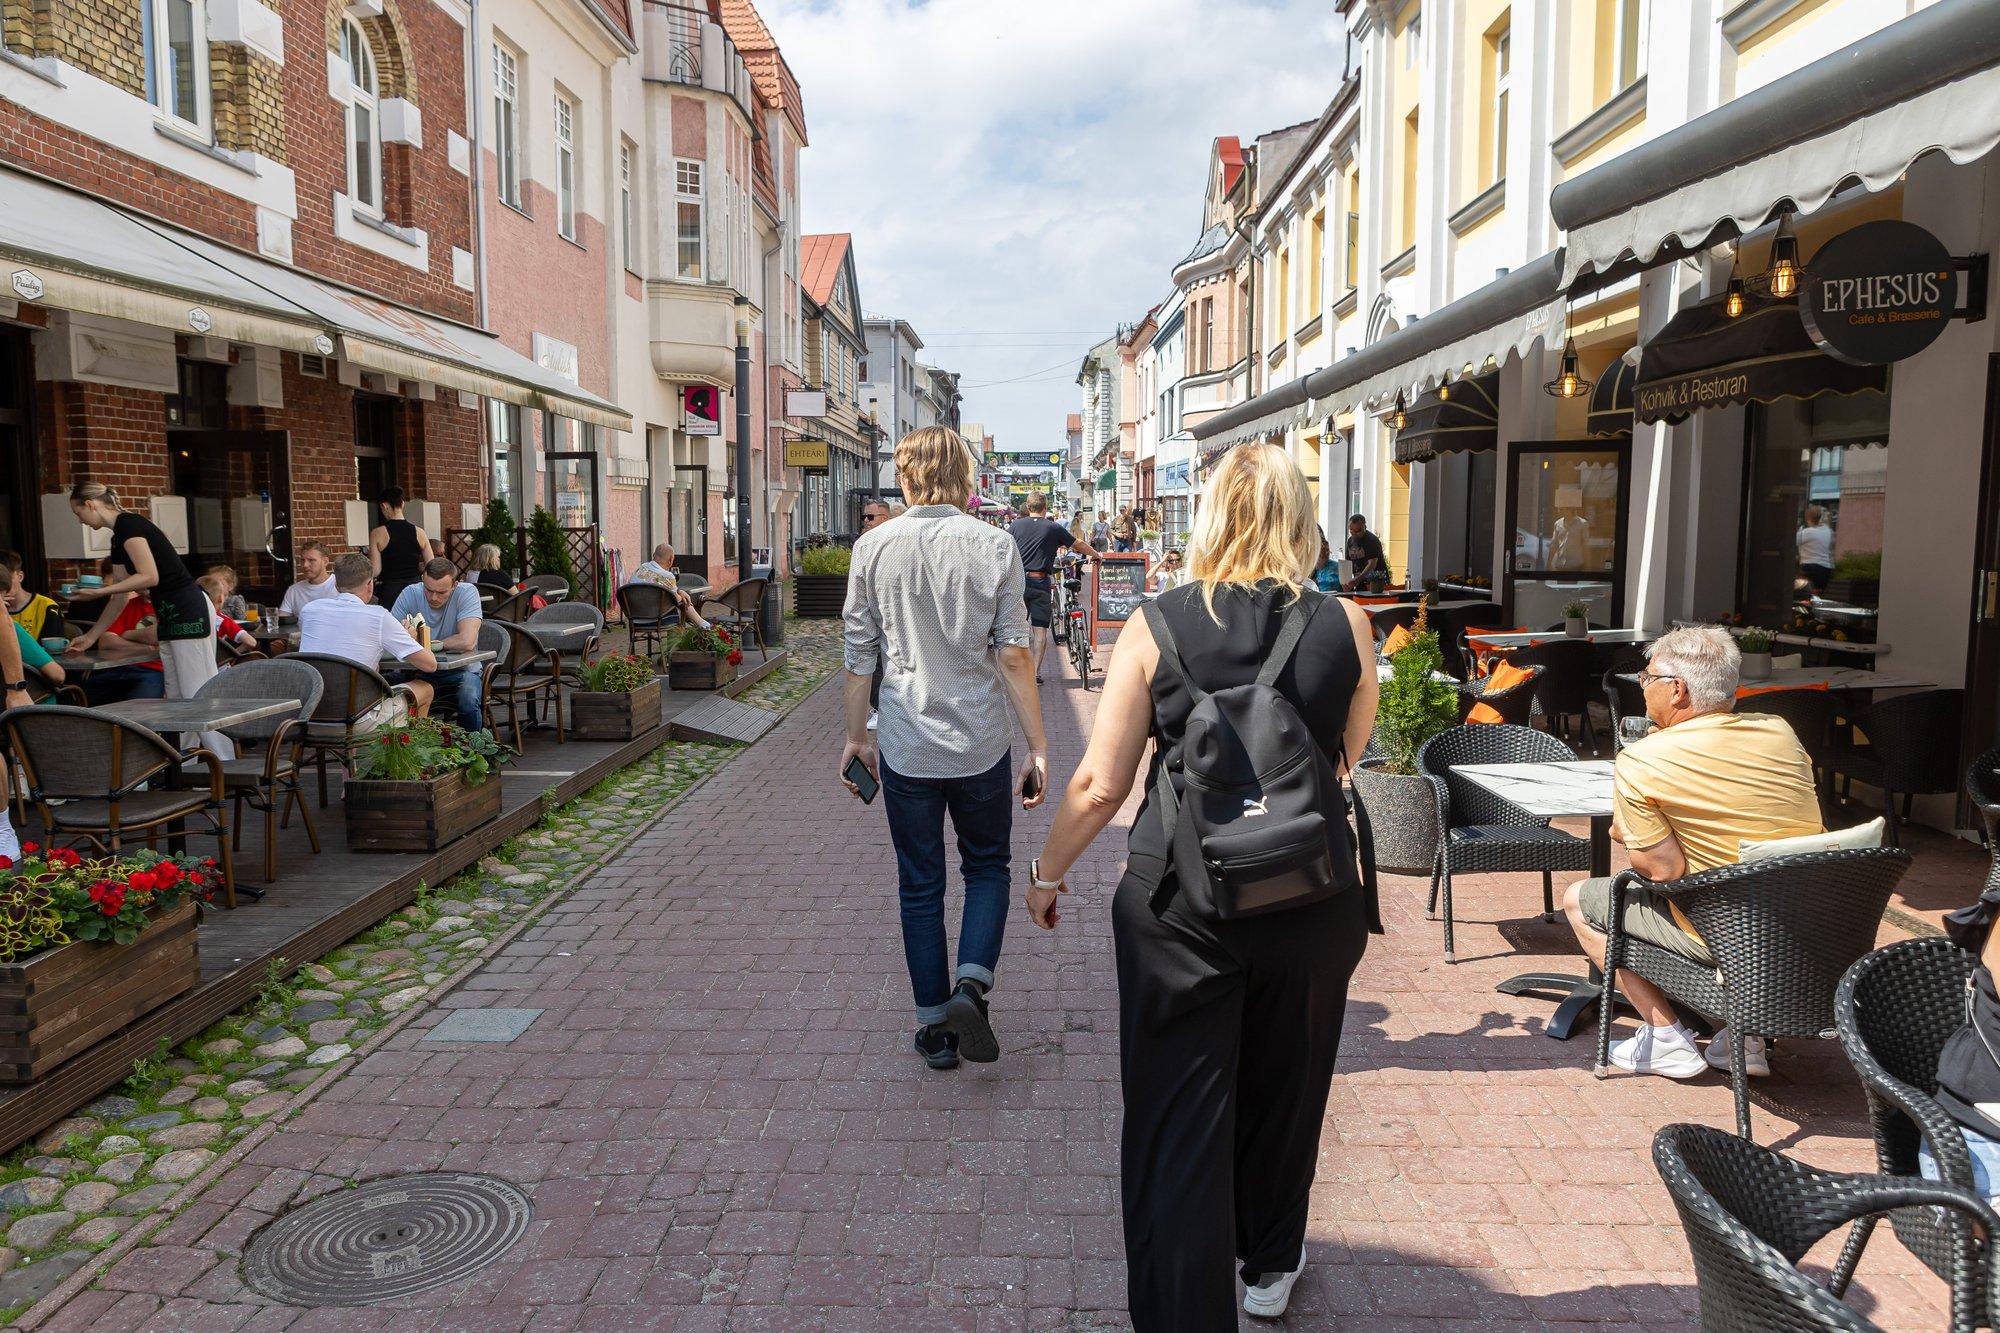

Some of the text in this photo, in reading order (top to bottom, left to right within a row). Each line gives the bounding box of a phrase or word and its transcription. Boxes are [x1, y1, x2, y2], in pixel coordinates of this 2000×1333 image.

[1823, 272, 1940, 312] EPHESUS
[1848, 308, 1942, 326] Cafe & Brasserie
[1641, 375, 1747, 411] Kohvik & Restoran
[790, 449, 824, 458] EHTEÄRI
[485, 1181, 520, 1206] PIPELIFE
